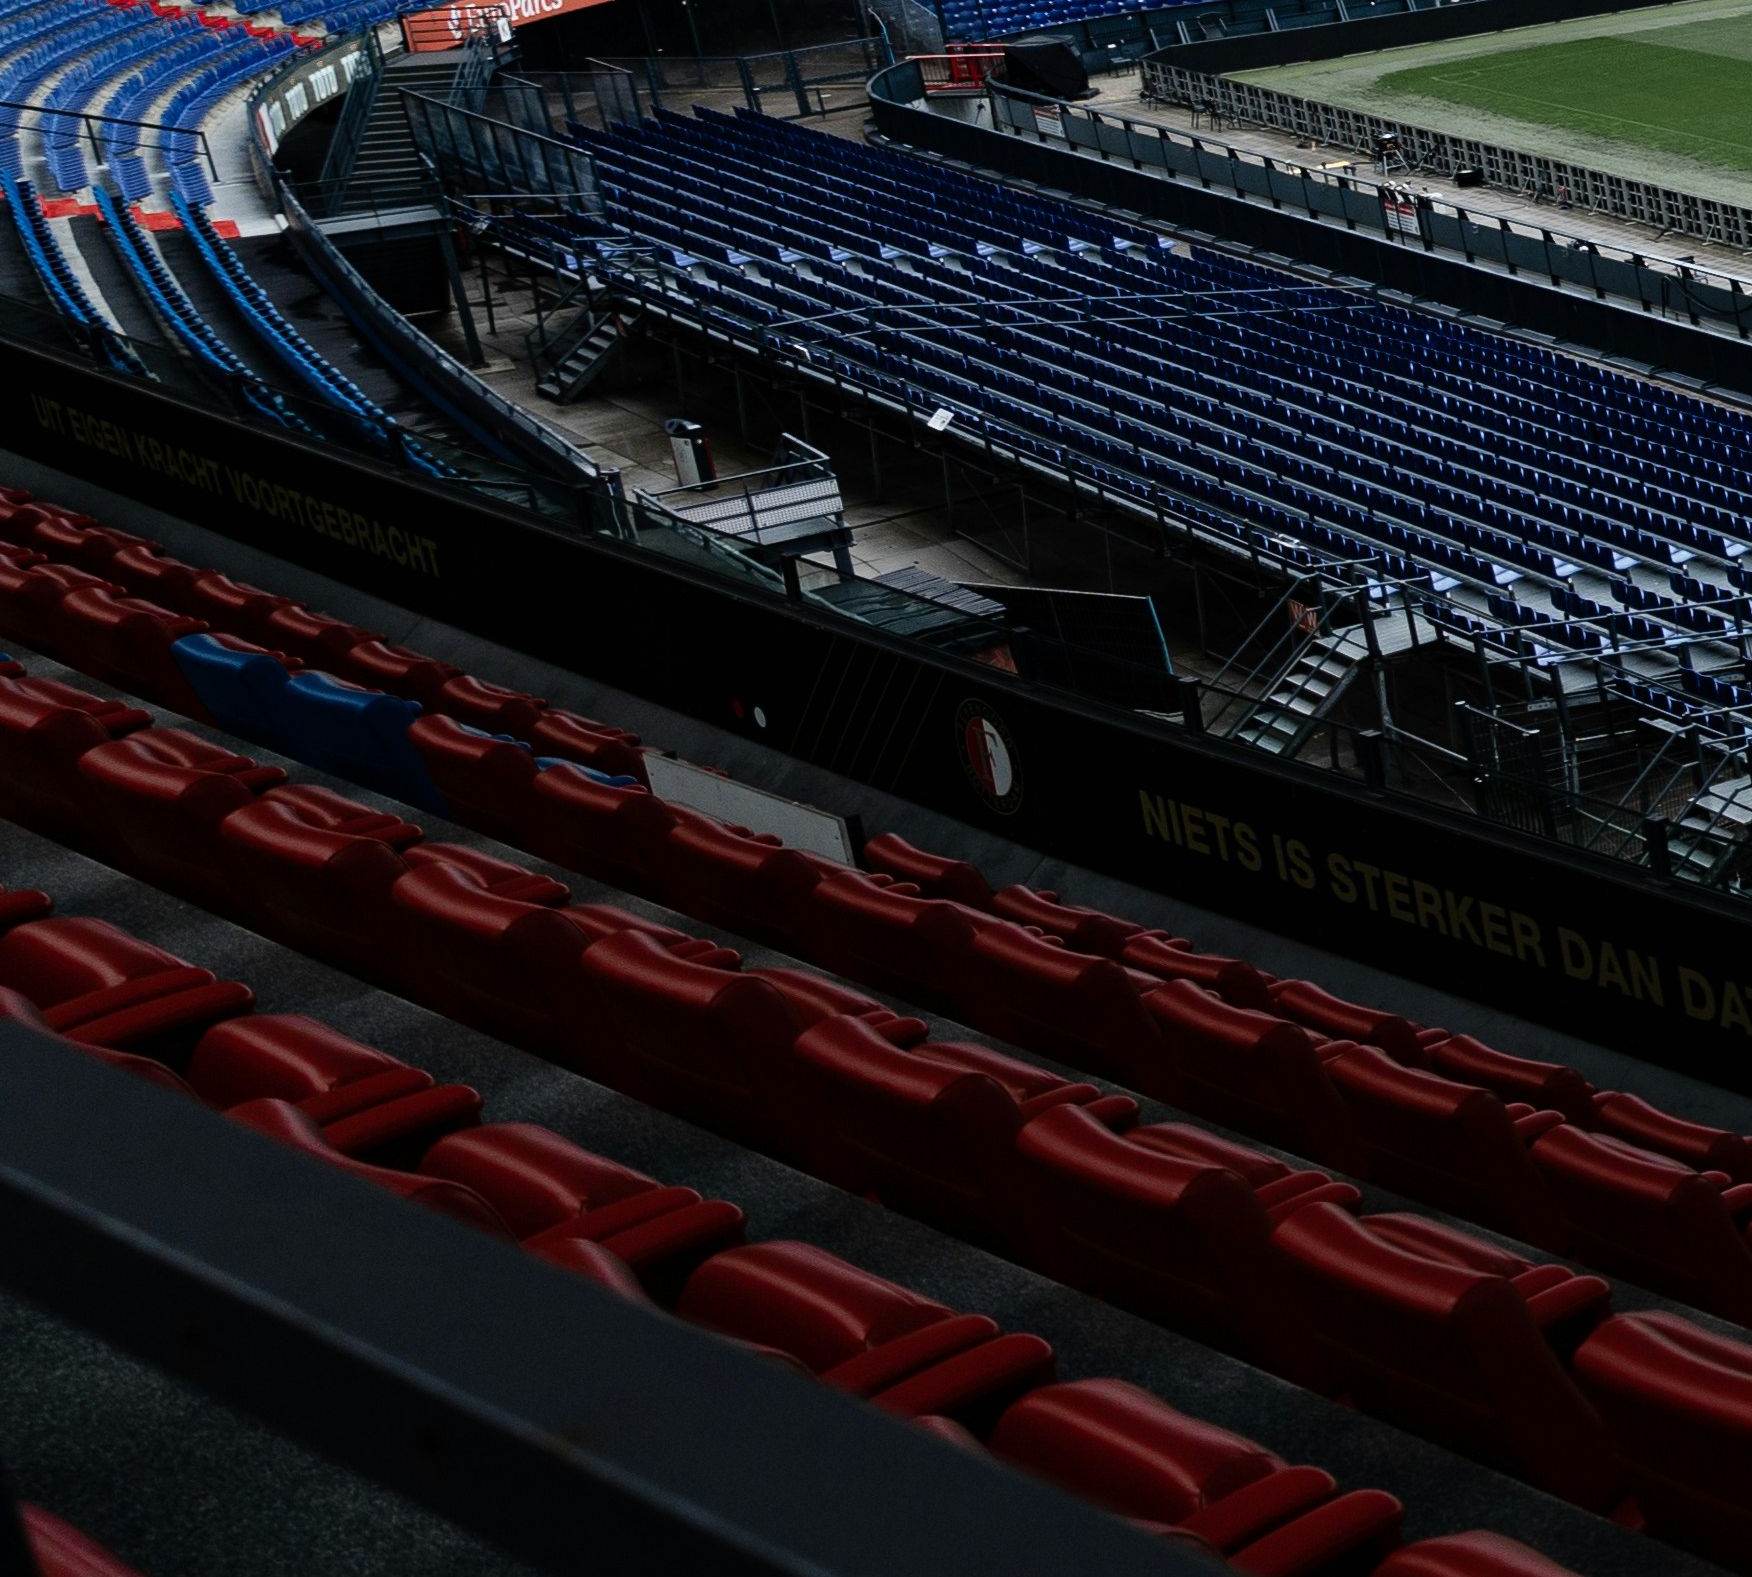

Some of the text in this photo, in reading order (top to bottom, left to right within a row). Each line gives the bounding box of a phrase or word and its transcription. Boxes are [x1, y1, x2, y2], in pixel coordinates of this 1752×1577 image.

[30, 392, 442, 579] UIT EIGEN KRACHT VOORTGEBRACHT
[1137, 789, 1264, 873] NIETS
[1272, 832, 1317, 892] IS
[1325, 851, 1548, 969] STERKER
[1555, 925, 1666, 1008] DAN
